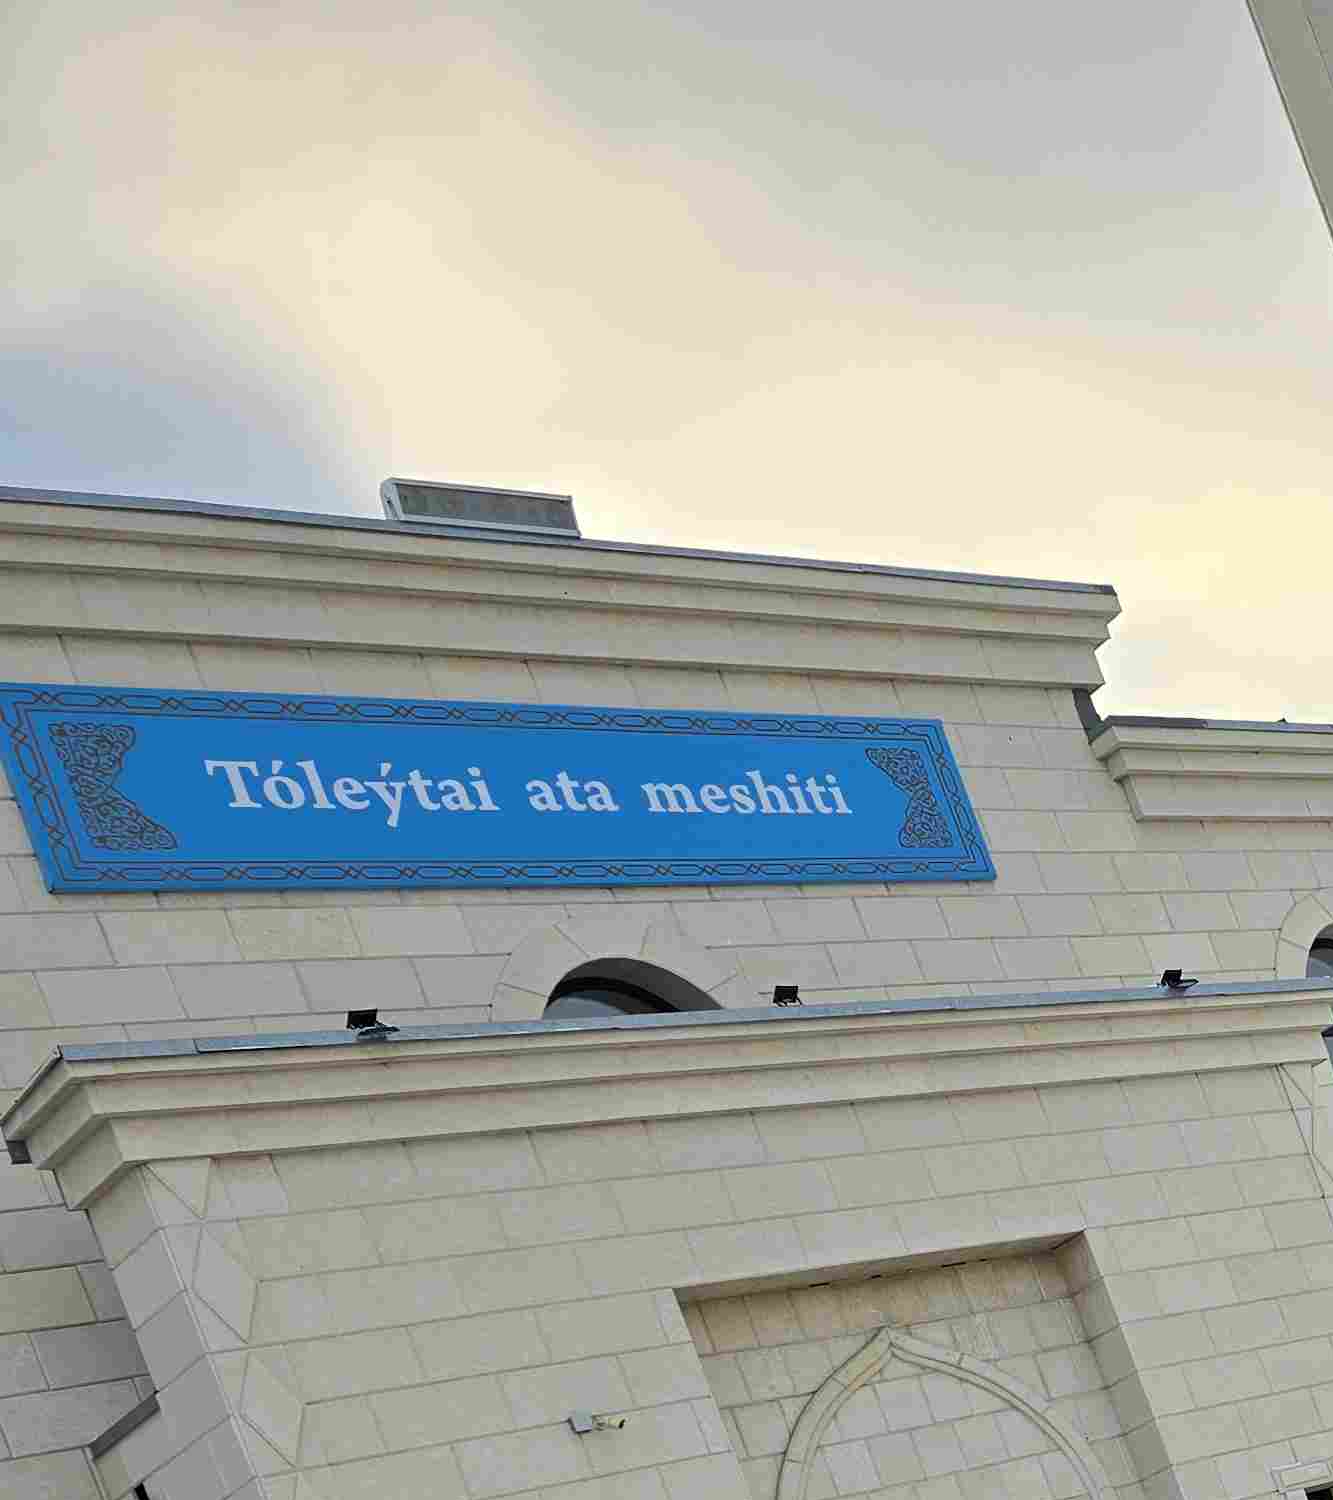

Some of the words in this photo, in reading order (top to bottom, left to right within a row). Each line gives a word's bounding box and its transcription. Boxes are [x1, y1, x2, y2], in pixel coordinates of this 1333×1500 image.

[204, 759, 501, 828] Tóleýtai
[526, 771, 620, 812] ata
[641, 770, 853, 815] meshiti
